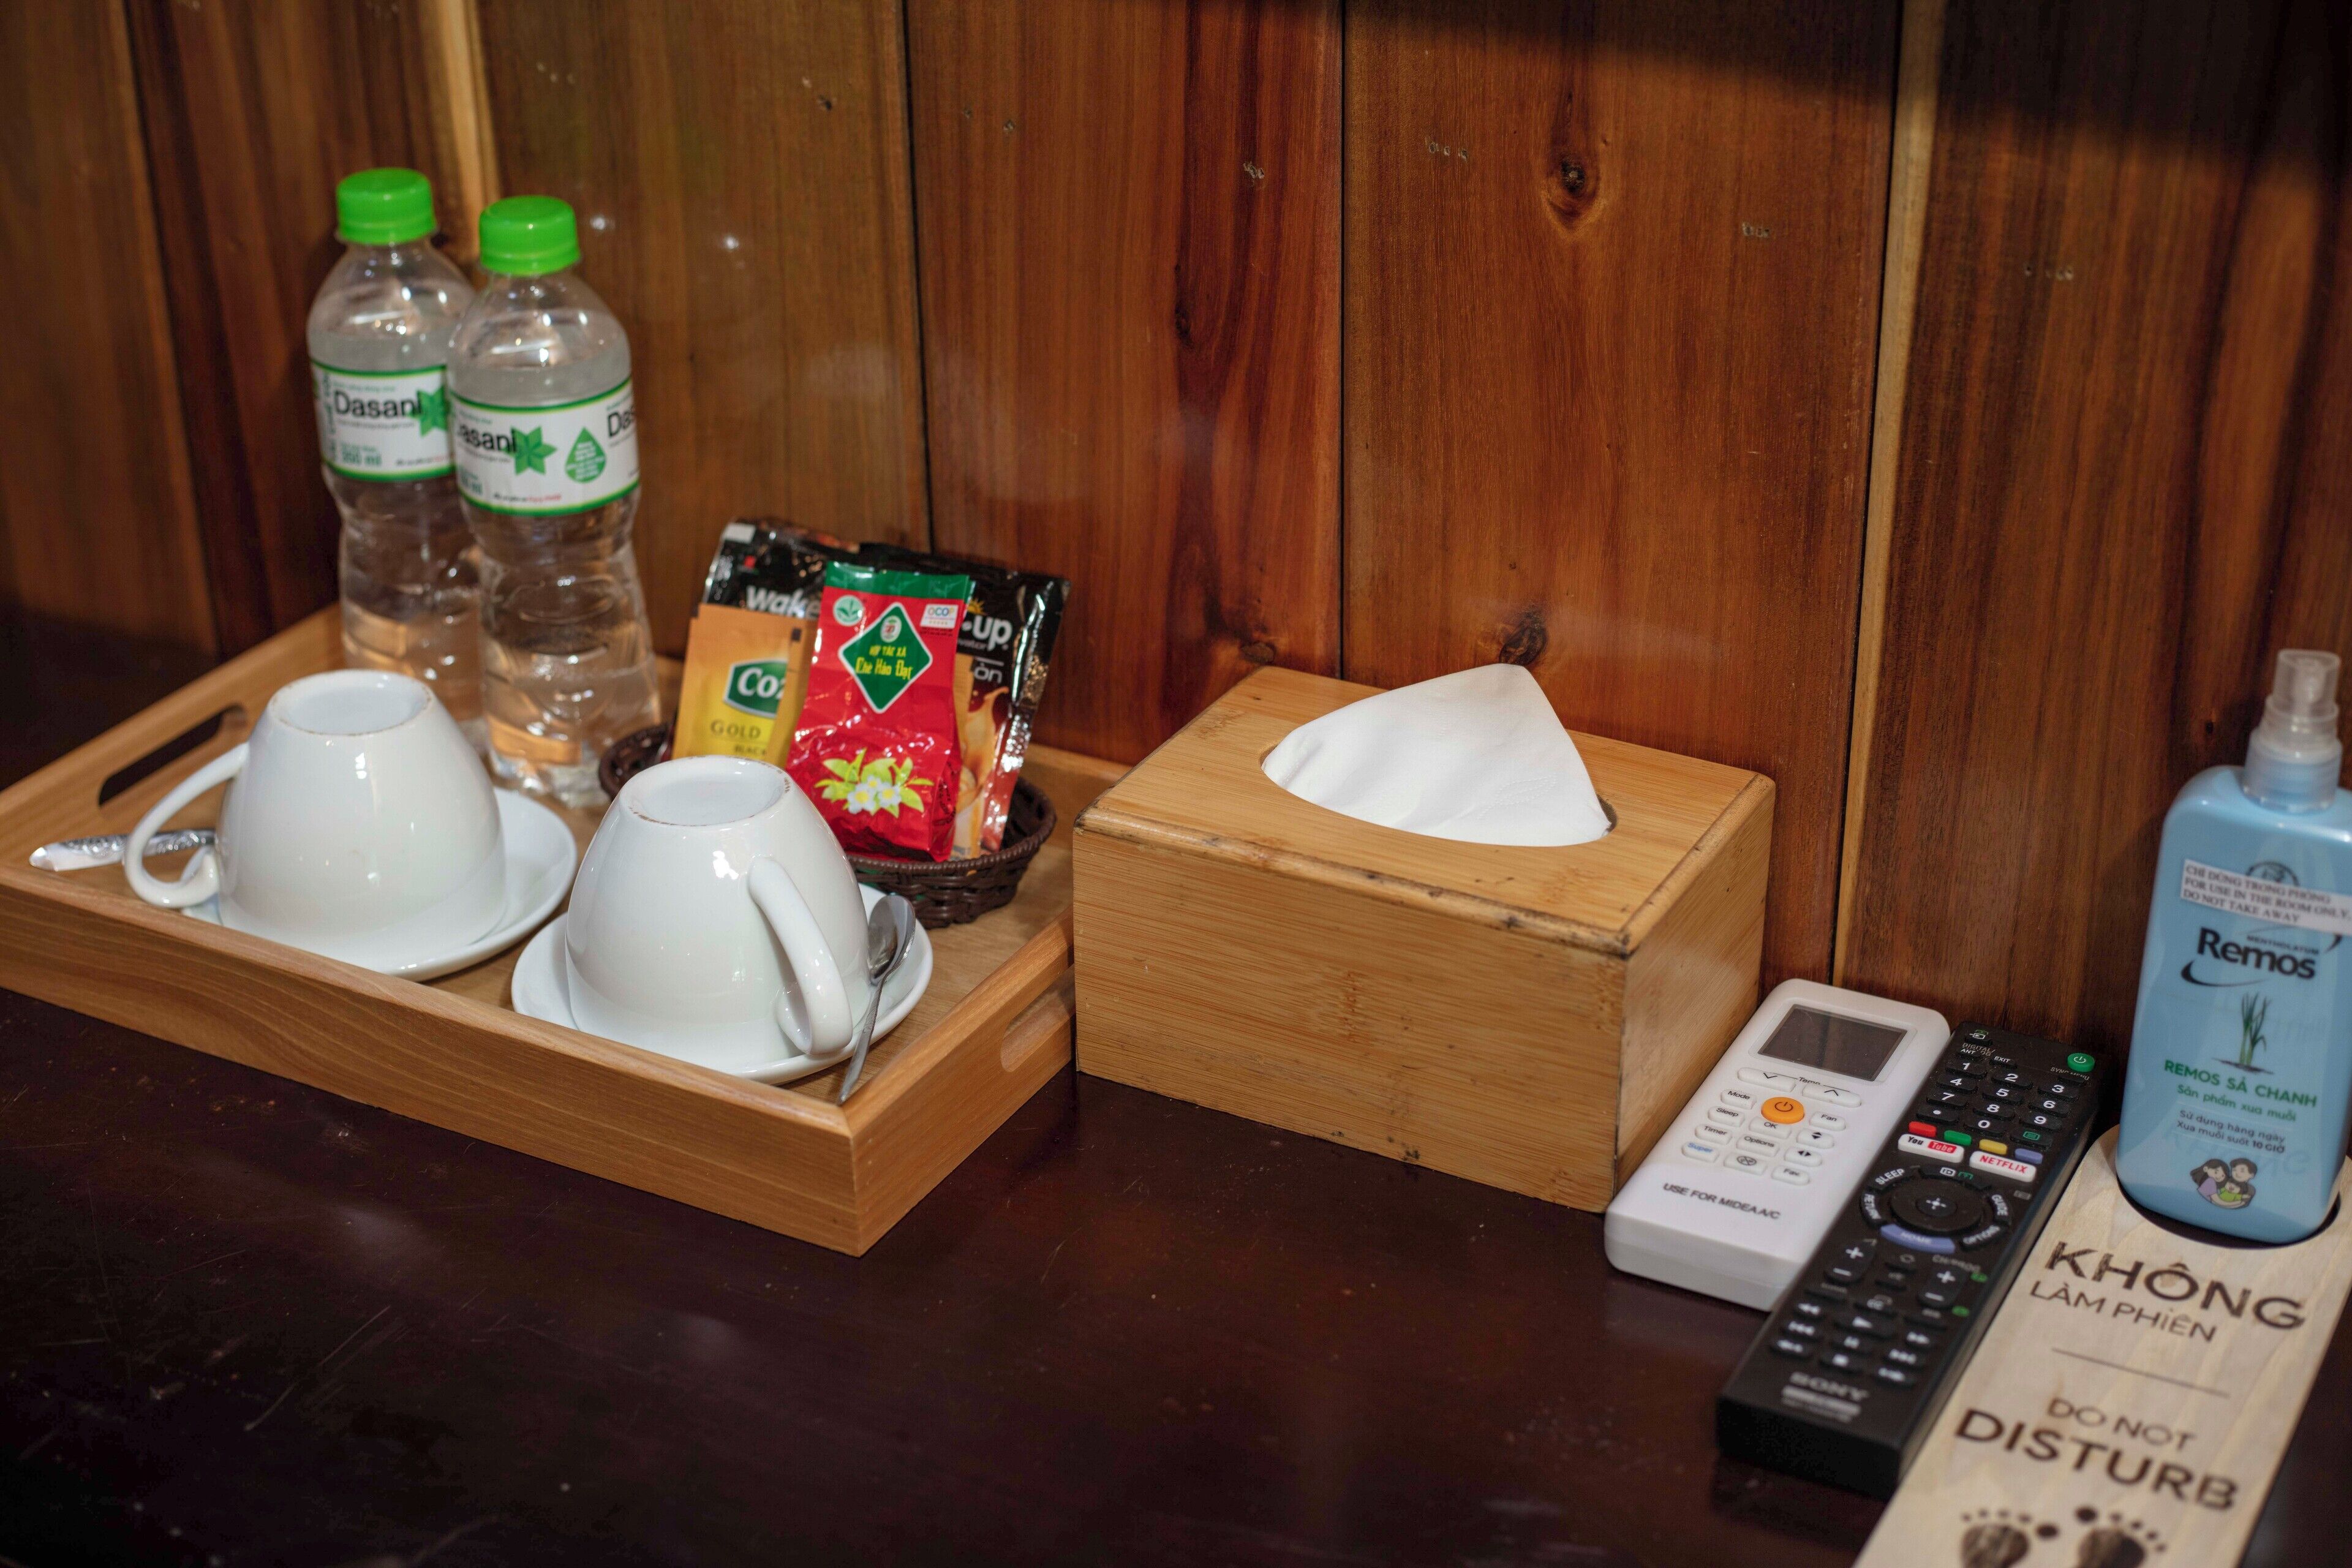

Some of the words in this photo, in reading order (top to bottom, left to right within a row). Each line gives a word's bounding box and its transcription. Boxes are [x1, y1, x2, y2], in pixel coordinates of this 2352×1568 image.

[334, 390, 423, 418] Dasani
[745, 586, 821, 620] Wake
[928, 607, 954, 616] OCOP
[710, 718, 761, 739] GOLD
[2185, 877, 2207, 889] FOR
[2210, 884, 2232, 897] USE
[2236, 889, 2247, 900] IN
[2250, 892, 2272, 905] THE
[2275, 899, 2312, 913] ROOM
[2184, 889, 2200, 899] DO
[2202, 894, 2226, 907] NOT
[2229, 899, 2260, 914] TAKE
[2264, 908, 2300, 922] AWAY
[2197, 926, 2316, 979] Remos
[2004, 1073, 2019, 1082] 2
[2164, 1059, 2220, 1086] REMOS
[2255, 1085, 2317, 1107] CHANH
[1728, 1090, 1750, 1100] Mode
[1996, 1088, 2010, 1097] 5
[1716, 1107, 1739, 1117] Sleep
[1986, 1104, 1999, 1113] 8
[2241, 1103, 2263, 1115] xua
[1764, 1121, 1777, 1129] OK
[1821, 1114, 1837, 1122] Fan
[2034, 1116, 2047, 1125] 9
[1705, 1126, 1727, 1136] Timer
[2177, 1121, 2196, 1132] Xua
[2252, 1140, 2263, 1149] 10
[2228, 1121, 2255, 1137] hàng
[1687, 1142, 1713, 1154] Super
[1744, 1136, 1774, 1148] Options
[1907, 1136, 1924, 1145] You
[1932, 1141, 1953, 1153] Tube
[1980, 1155, 2028, 1174] NETFLIX
[1875, 1168, 1905, 1185] SLEEP
[1663, 1183, 1689, 1196] USE
[1691, 1190, 1717, 1204] FOR
[1718, 1197, 1757, 1214] MIDEA
[1991, 1194, 2008, 1216] GUIDE
[2044, 1241, 2306, 1330] KHÔNG
[2029, 1280, 2107, 1314] LÀM
[1790, 1371, 1869, 1402] SONY
[2046, 1397, 2107, 1428] DO
[2114, 1415, 2196, 1452] NOT
[1954, 1407, 2239, 1510] DISTURB
